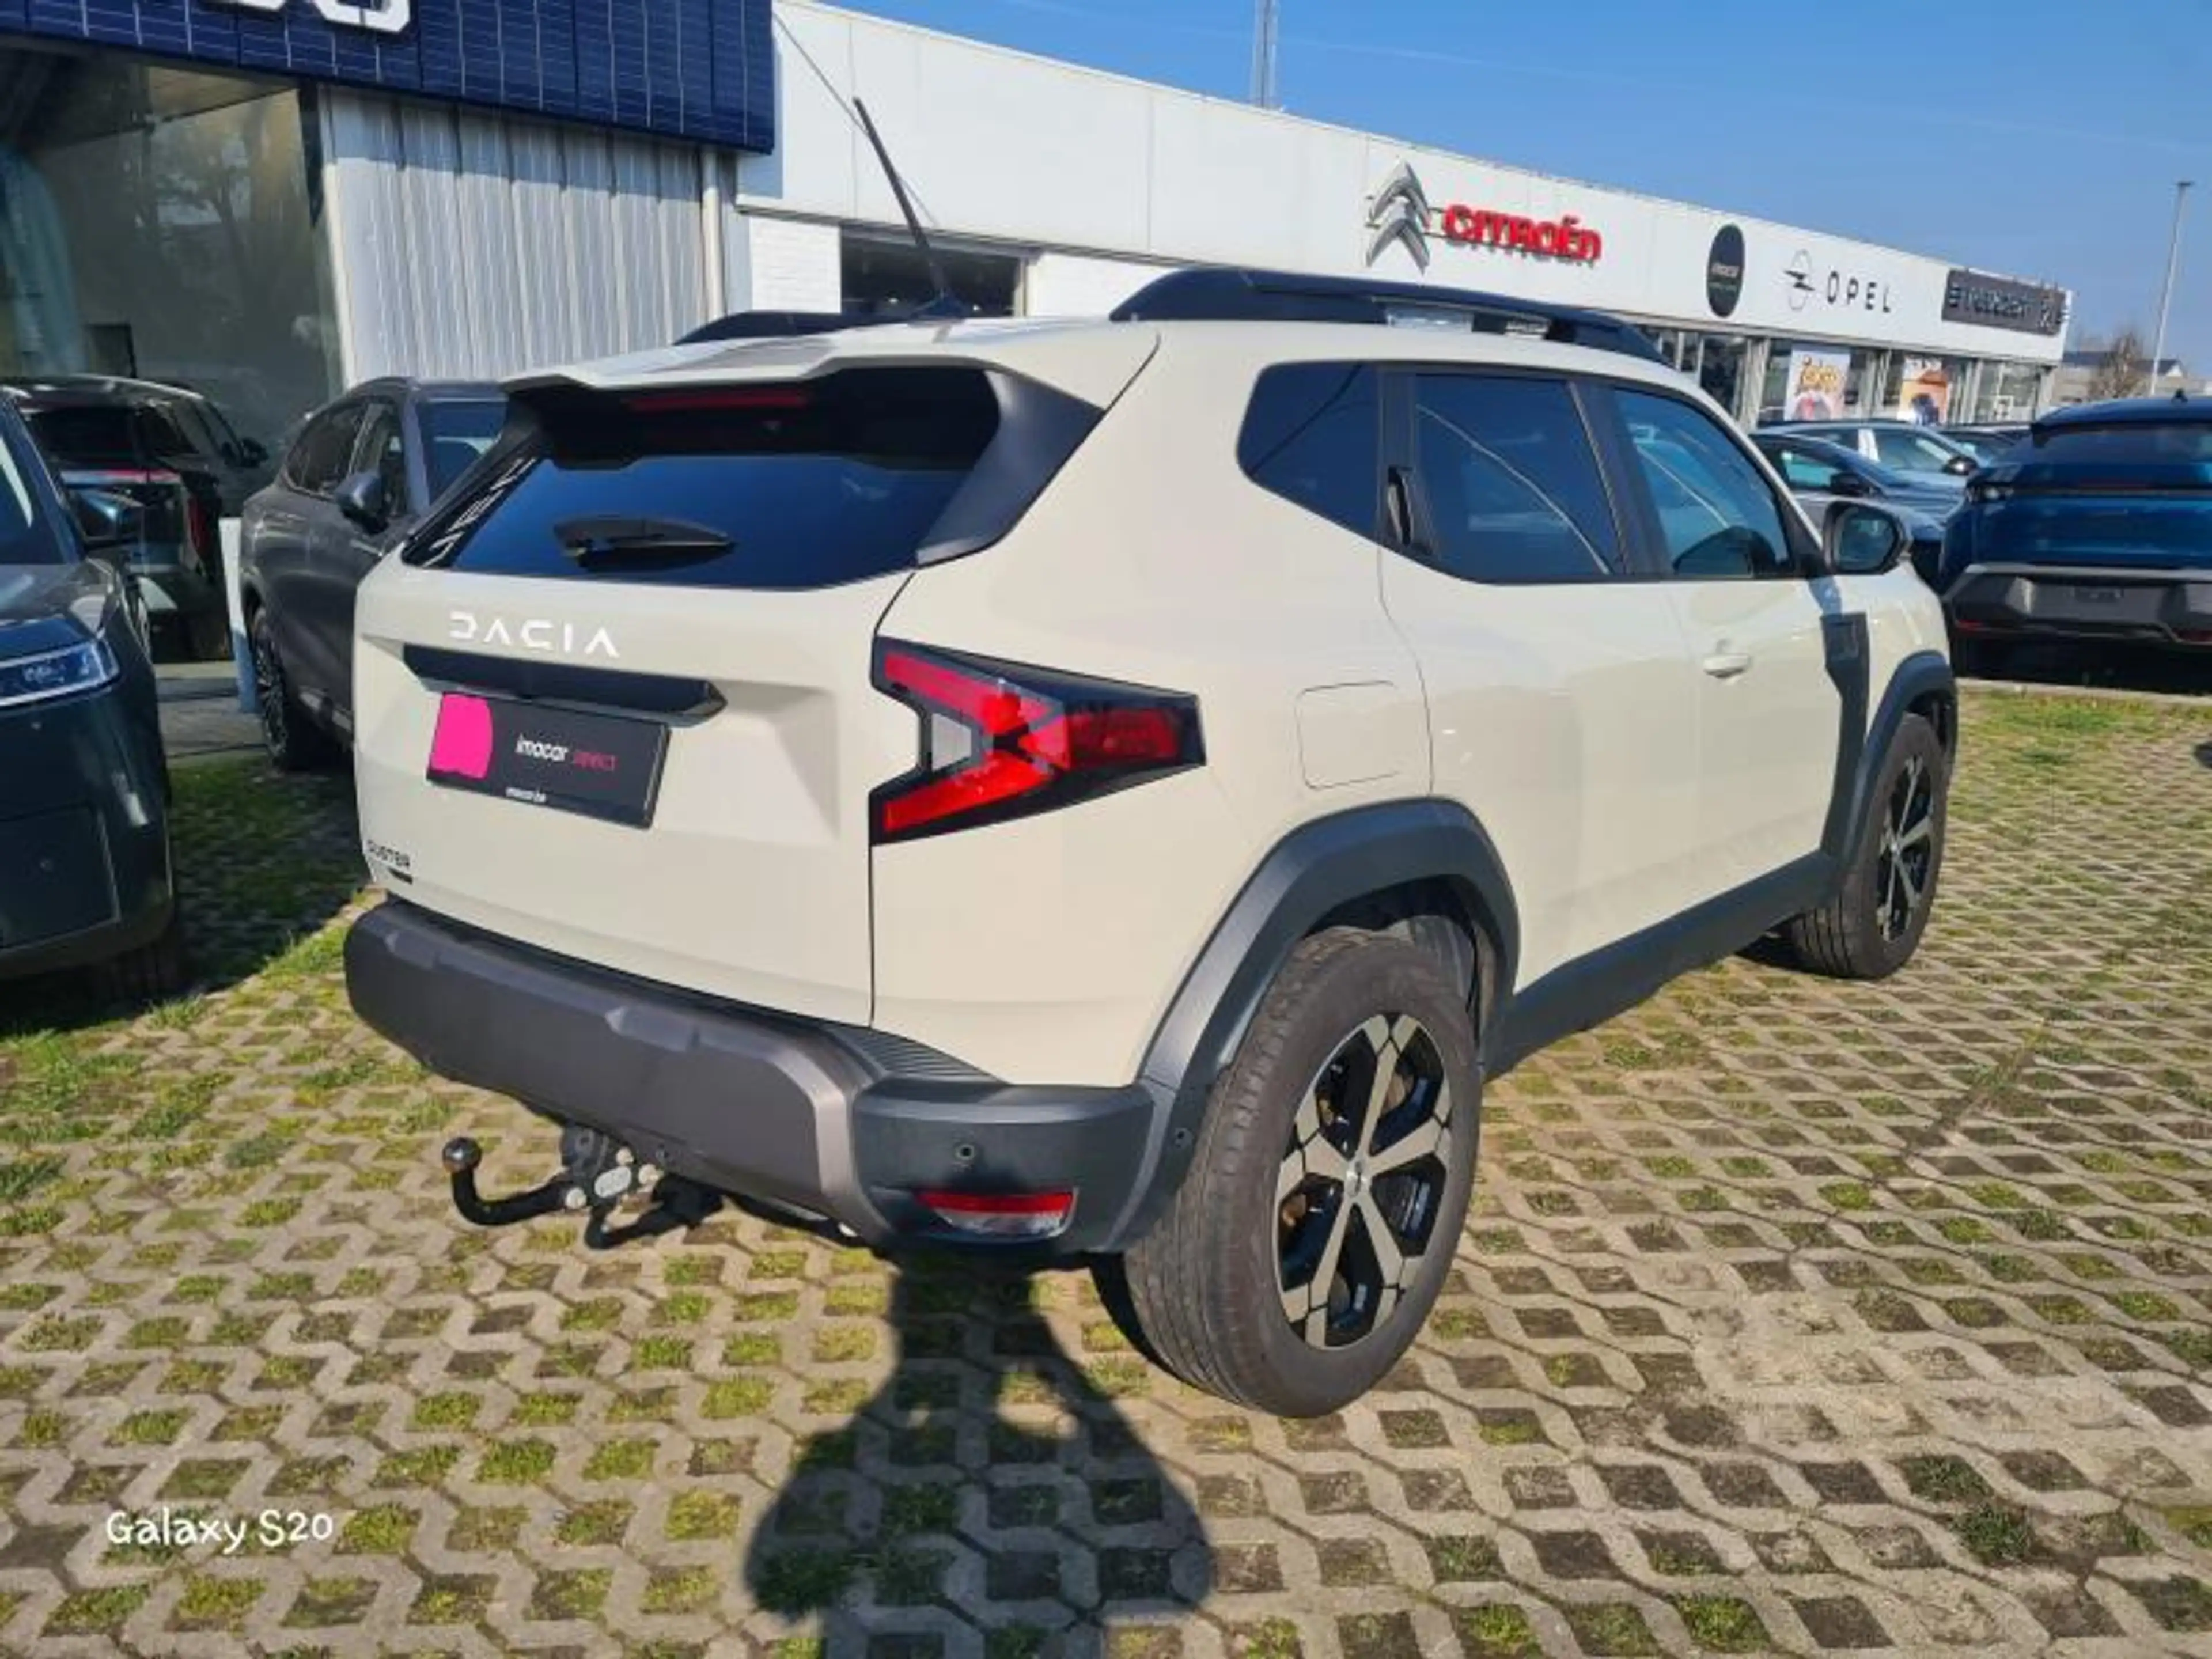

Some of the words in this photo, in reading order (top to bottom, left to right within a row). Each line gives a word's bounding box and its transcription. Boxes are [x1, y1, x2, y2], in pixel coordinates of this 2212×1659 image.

[1827, 270, 1891, 313] OPEL
[449, 611, 620, 658] DACIA
[516, 733, 569, 762] imocar
